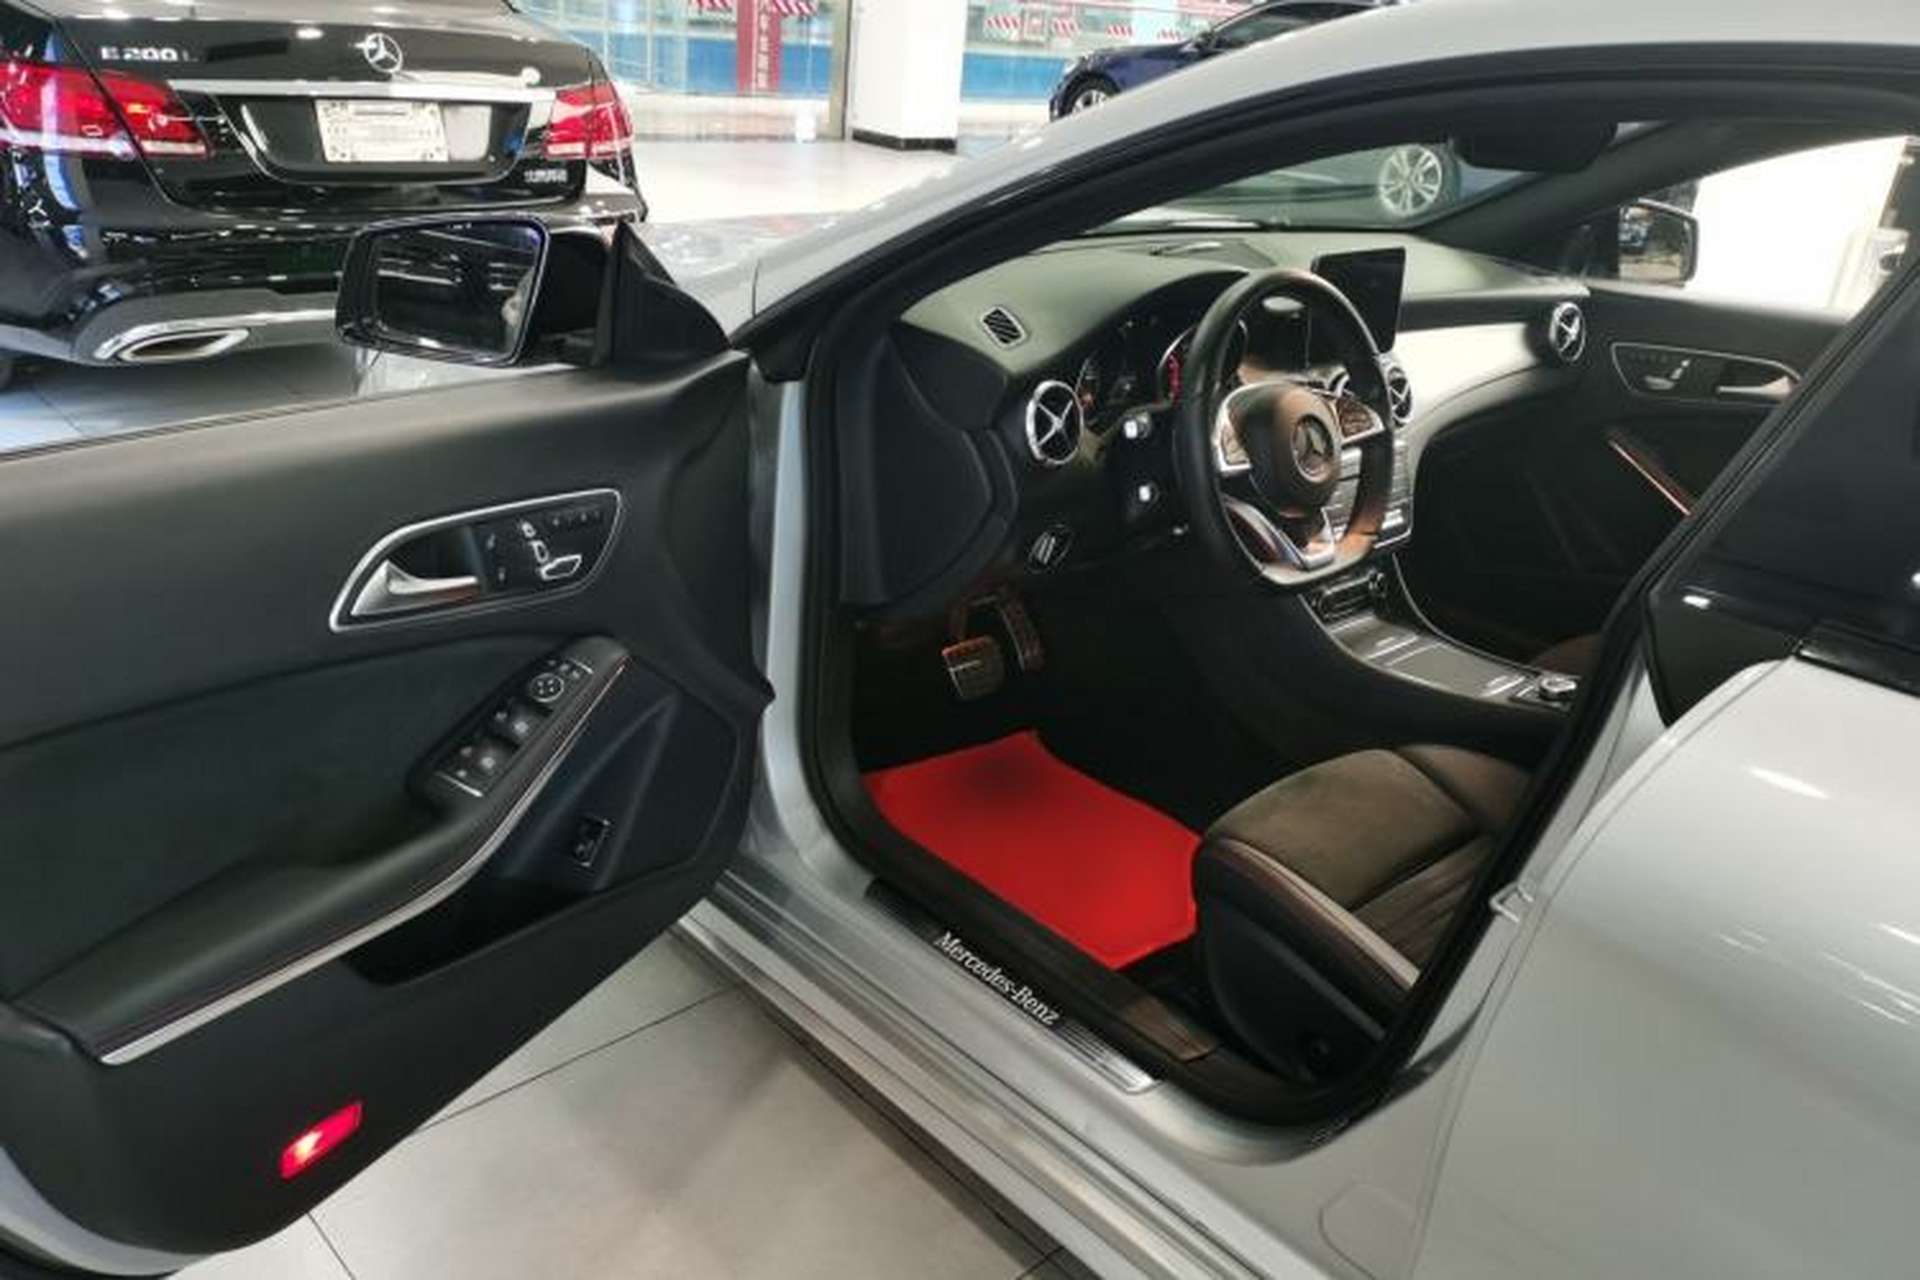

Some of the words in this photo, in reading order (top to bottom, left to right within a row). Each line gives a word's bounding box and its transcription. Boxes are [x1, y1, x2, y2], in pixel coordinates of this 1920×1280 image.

[101, 47, 120, 60] E
[122, 46, 179, 62] 200
[934, 930, 1060, 1025] Mercedes-Benz
